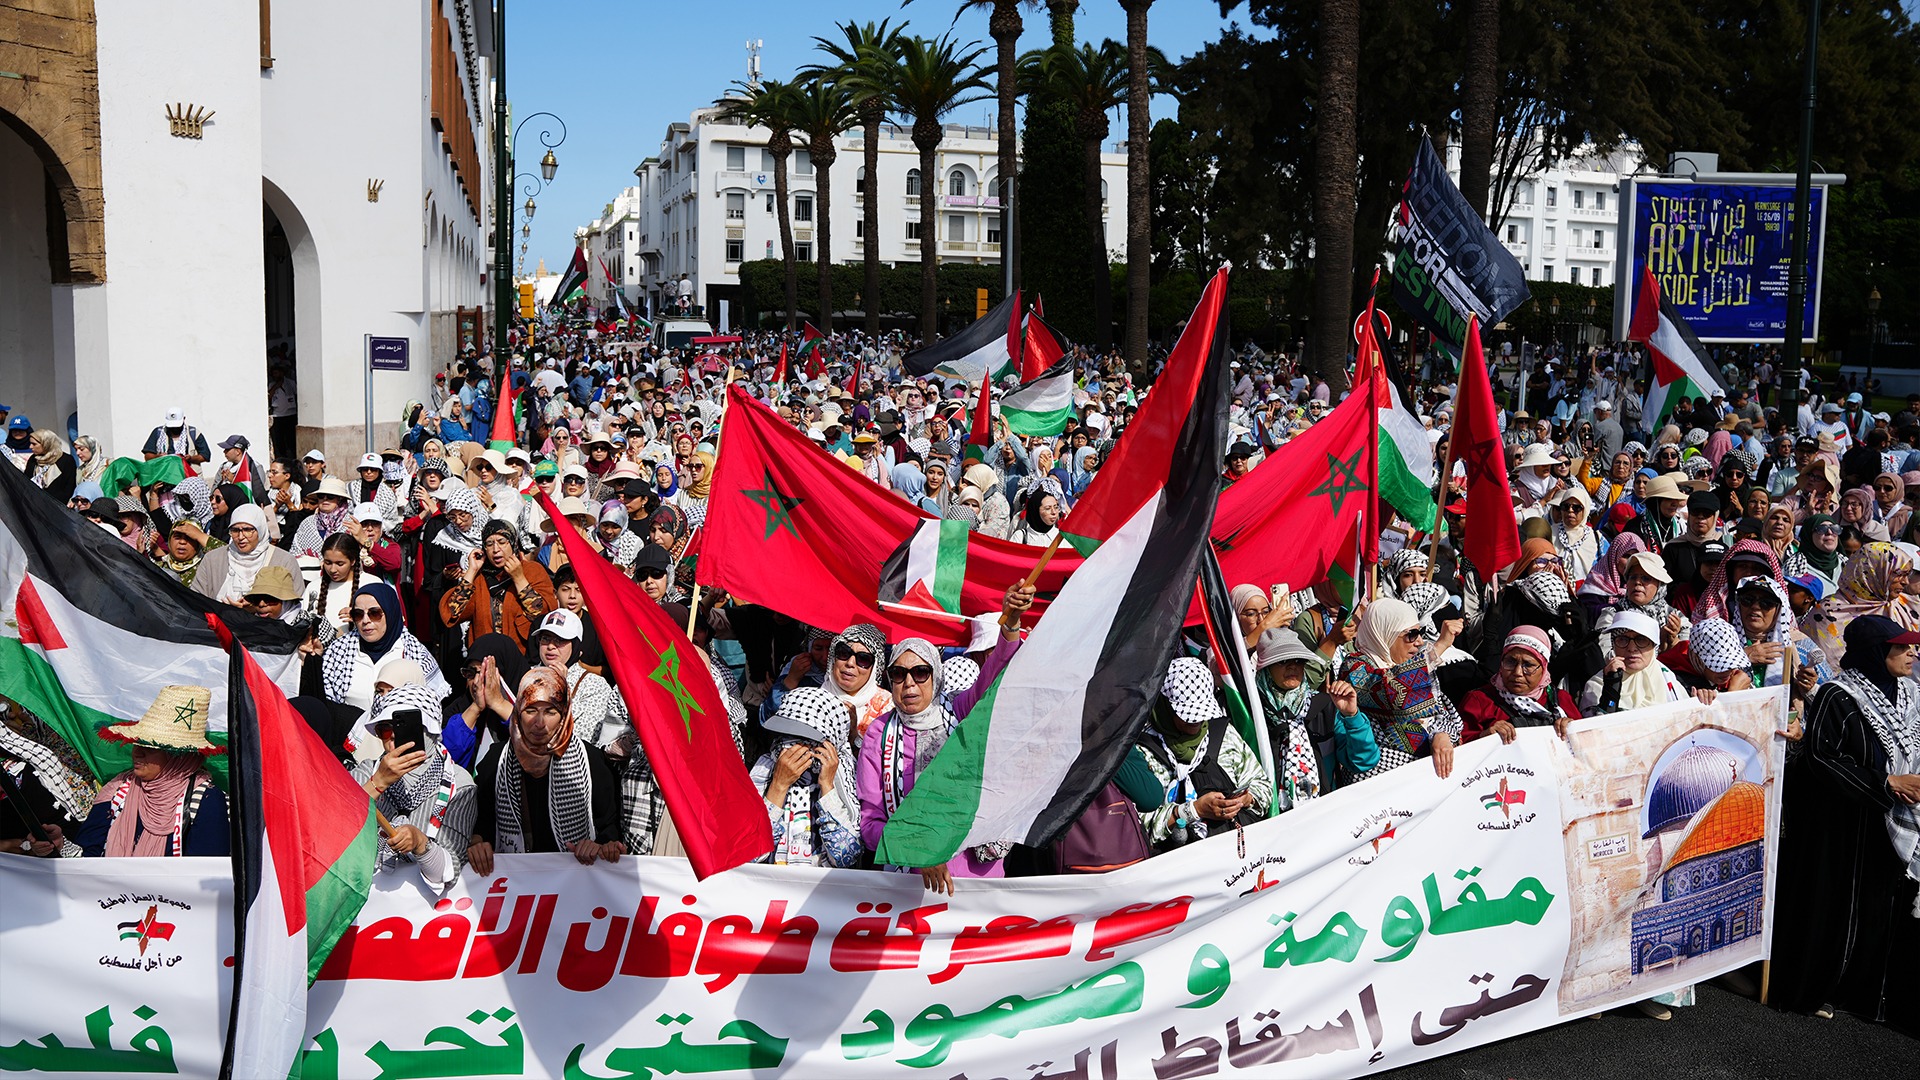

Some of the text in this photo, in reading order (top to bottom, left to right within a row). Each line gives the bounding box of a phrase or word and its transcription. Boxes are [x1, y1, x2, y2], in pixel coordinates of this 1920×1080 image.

[1650, 196, 1708, 223] STREET
[1723, 199, 1746, 236] فن
[1754, 202, 1781, 211] VERNISSAGE
[1757, 212, 1781, 222] LE 26/09
[1764, 223, 1780, 231] 18H30
[1404, 219, 1447, 286] FOR
[1648, 222, 1706, 273] ART
[1704, 231, 1755, 273] الشارع
[1653, 272, 1700, 305] SIDE
[883, 733, 895, 815] ALESTINE
[1484, 764, 1505, 778] العمل
[1507, 763, 1535, 778] مجموعة
[1350, 806, 1414, 840] مجموعة العمل الوطنية
[1477, 812, 1536, 832] من أجل فلسطين
[1223, 853, 1287, 888] مجموعة العمل الوطنية
[1593, 848, 1613, 858] MOROCCO
[97, 893, 192, 911] مجموعة العمل الوطنية
[1262, 865, 1555, 969] مقاومة
[314, 877, 1195, 994] مع معركة طوفان الأقص
[98, 953, 183, 972] من أجل فلسطين
[1175, 943, 1231, 1009] و
[840, 960, 1146, 1068] صمود
[1411, 972, 1550, 1046] حتى
[0, 1004, 178, 1074] فلس
[1151, 982, 1386, 1080] إسقاط
